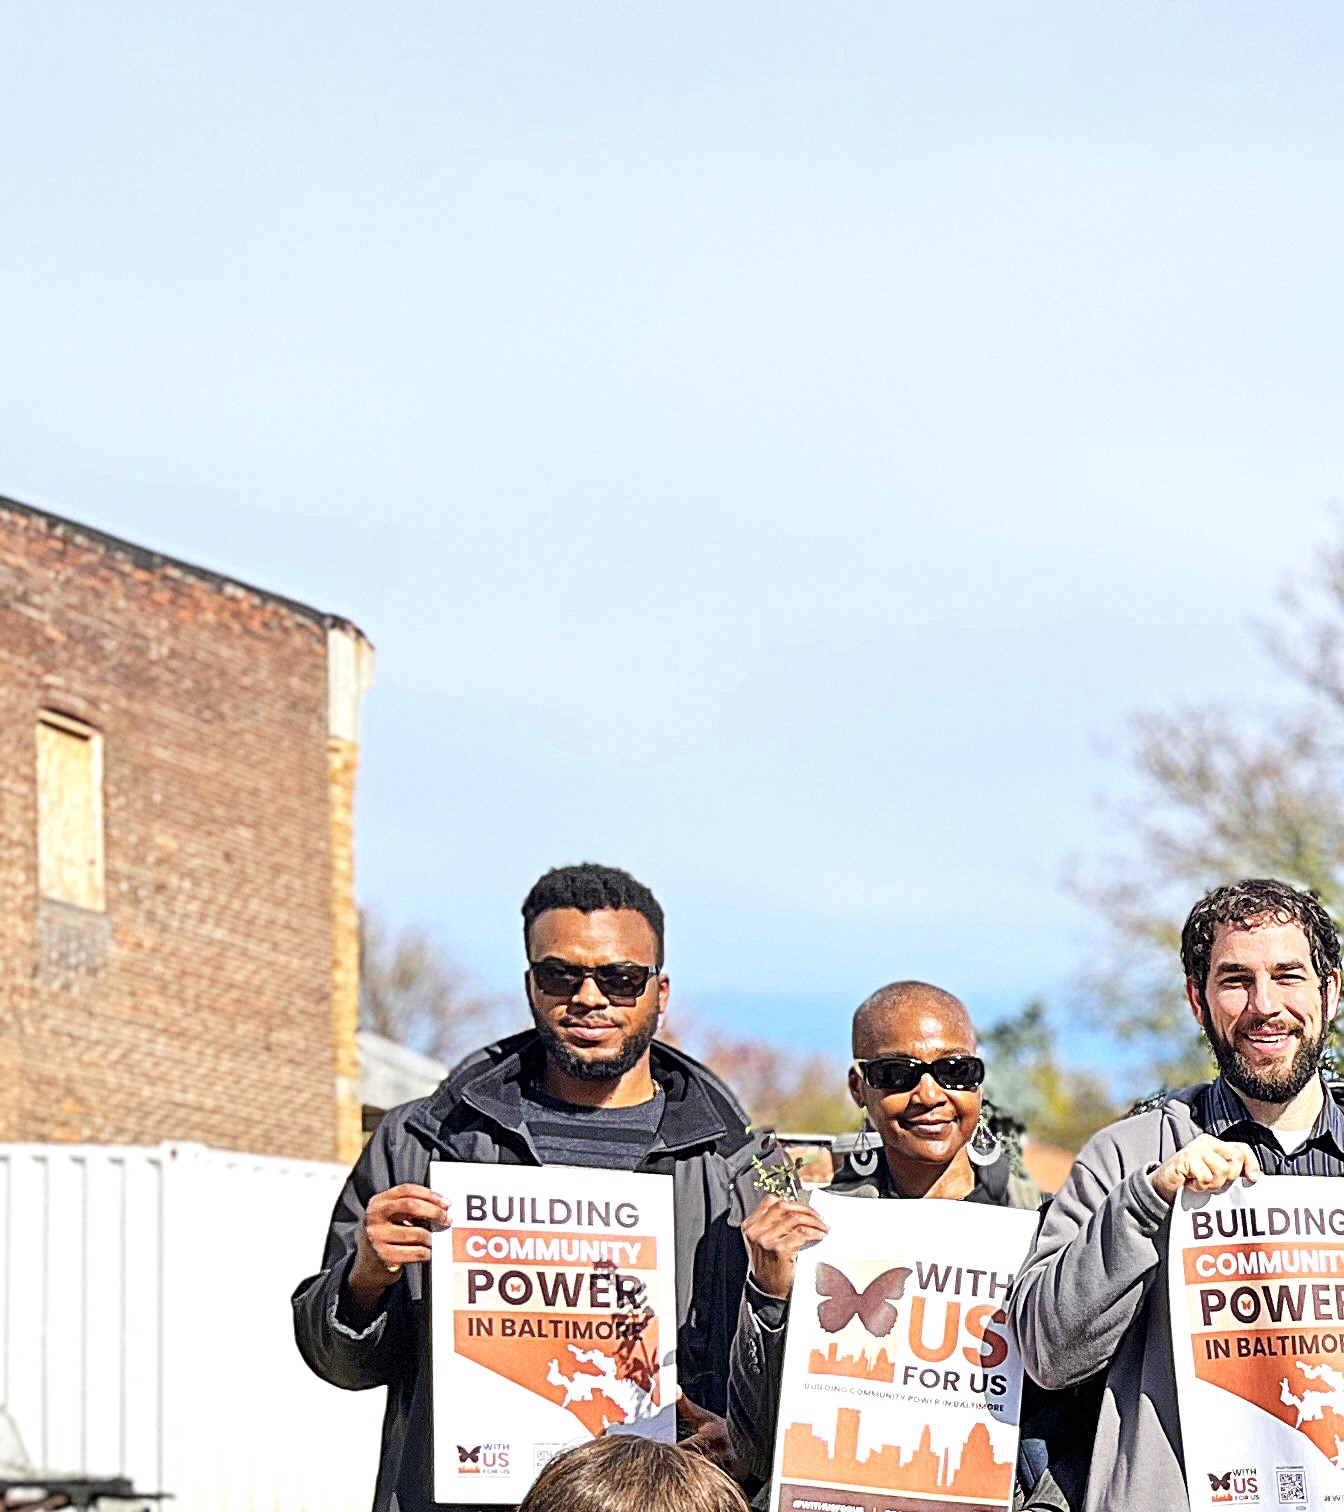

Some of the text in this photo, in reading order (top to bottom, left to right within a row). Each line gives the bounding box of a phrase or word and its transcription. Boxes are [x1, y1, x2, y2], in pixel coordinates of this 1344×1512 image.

[466, 1194, 640, 1228] BUILDING
[466, 1235, 641, 1264] COMMUNITY
[467, 1269, 643, 1310] POWER
[916, 1261, 1015, 1299] WITH
[468, 1318, 643, 1341] IN BALTIMORE
[909, 1295, 1009, 1368] US
[1205, 1338, 1231, 1360] IN
[903, 1366, 1008, 1396] FOR US
[850, 1386, 905, 1400] COMMUNITY
[908, 1395, 940, 1404] POWER
[954, 1401, 1004, 1412] BALTIMORE
[483, 1452, 509, 1467] US
[1232, 1468, 1257, 1476] WITH
[1233, 1478, 1258, 1493] US
